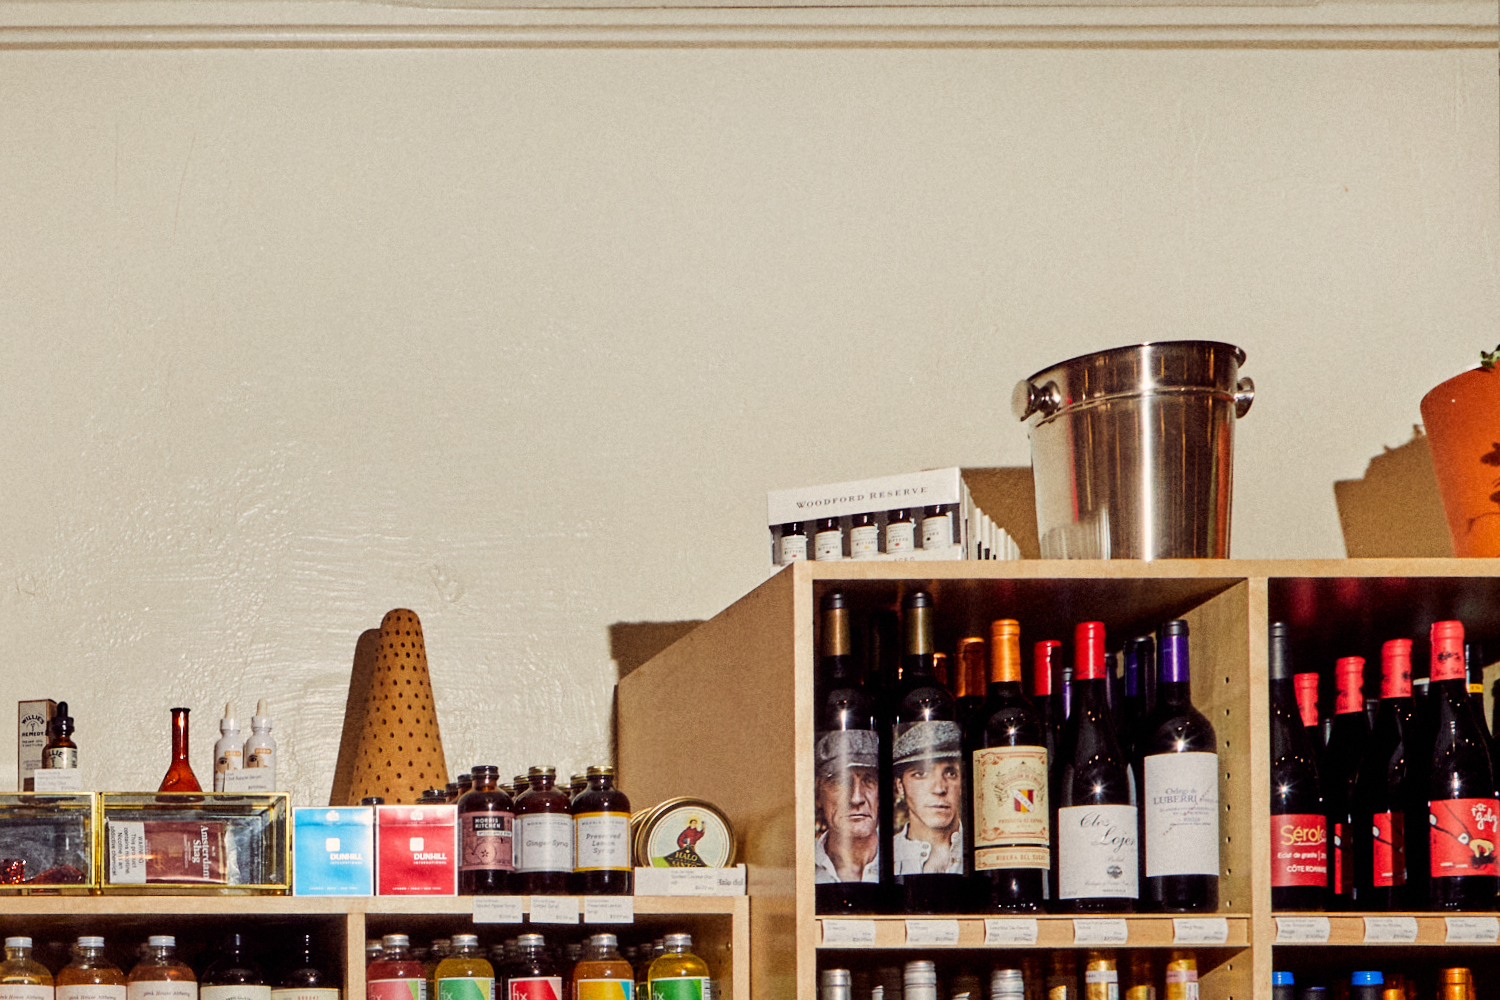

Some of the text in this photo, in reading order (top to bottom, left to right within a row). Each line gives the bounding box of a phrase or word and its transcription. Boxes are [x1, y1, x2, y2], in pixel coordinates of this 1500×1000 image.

[796, 487, 928, 508] WOODFORD RESERVE
[192, 839, 200, 863] Shag
[675, 851, 698, 861] HALO
